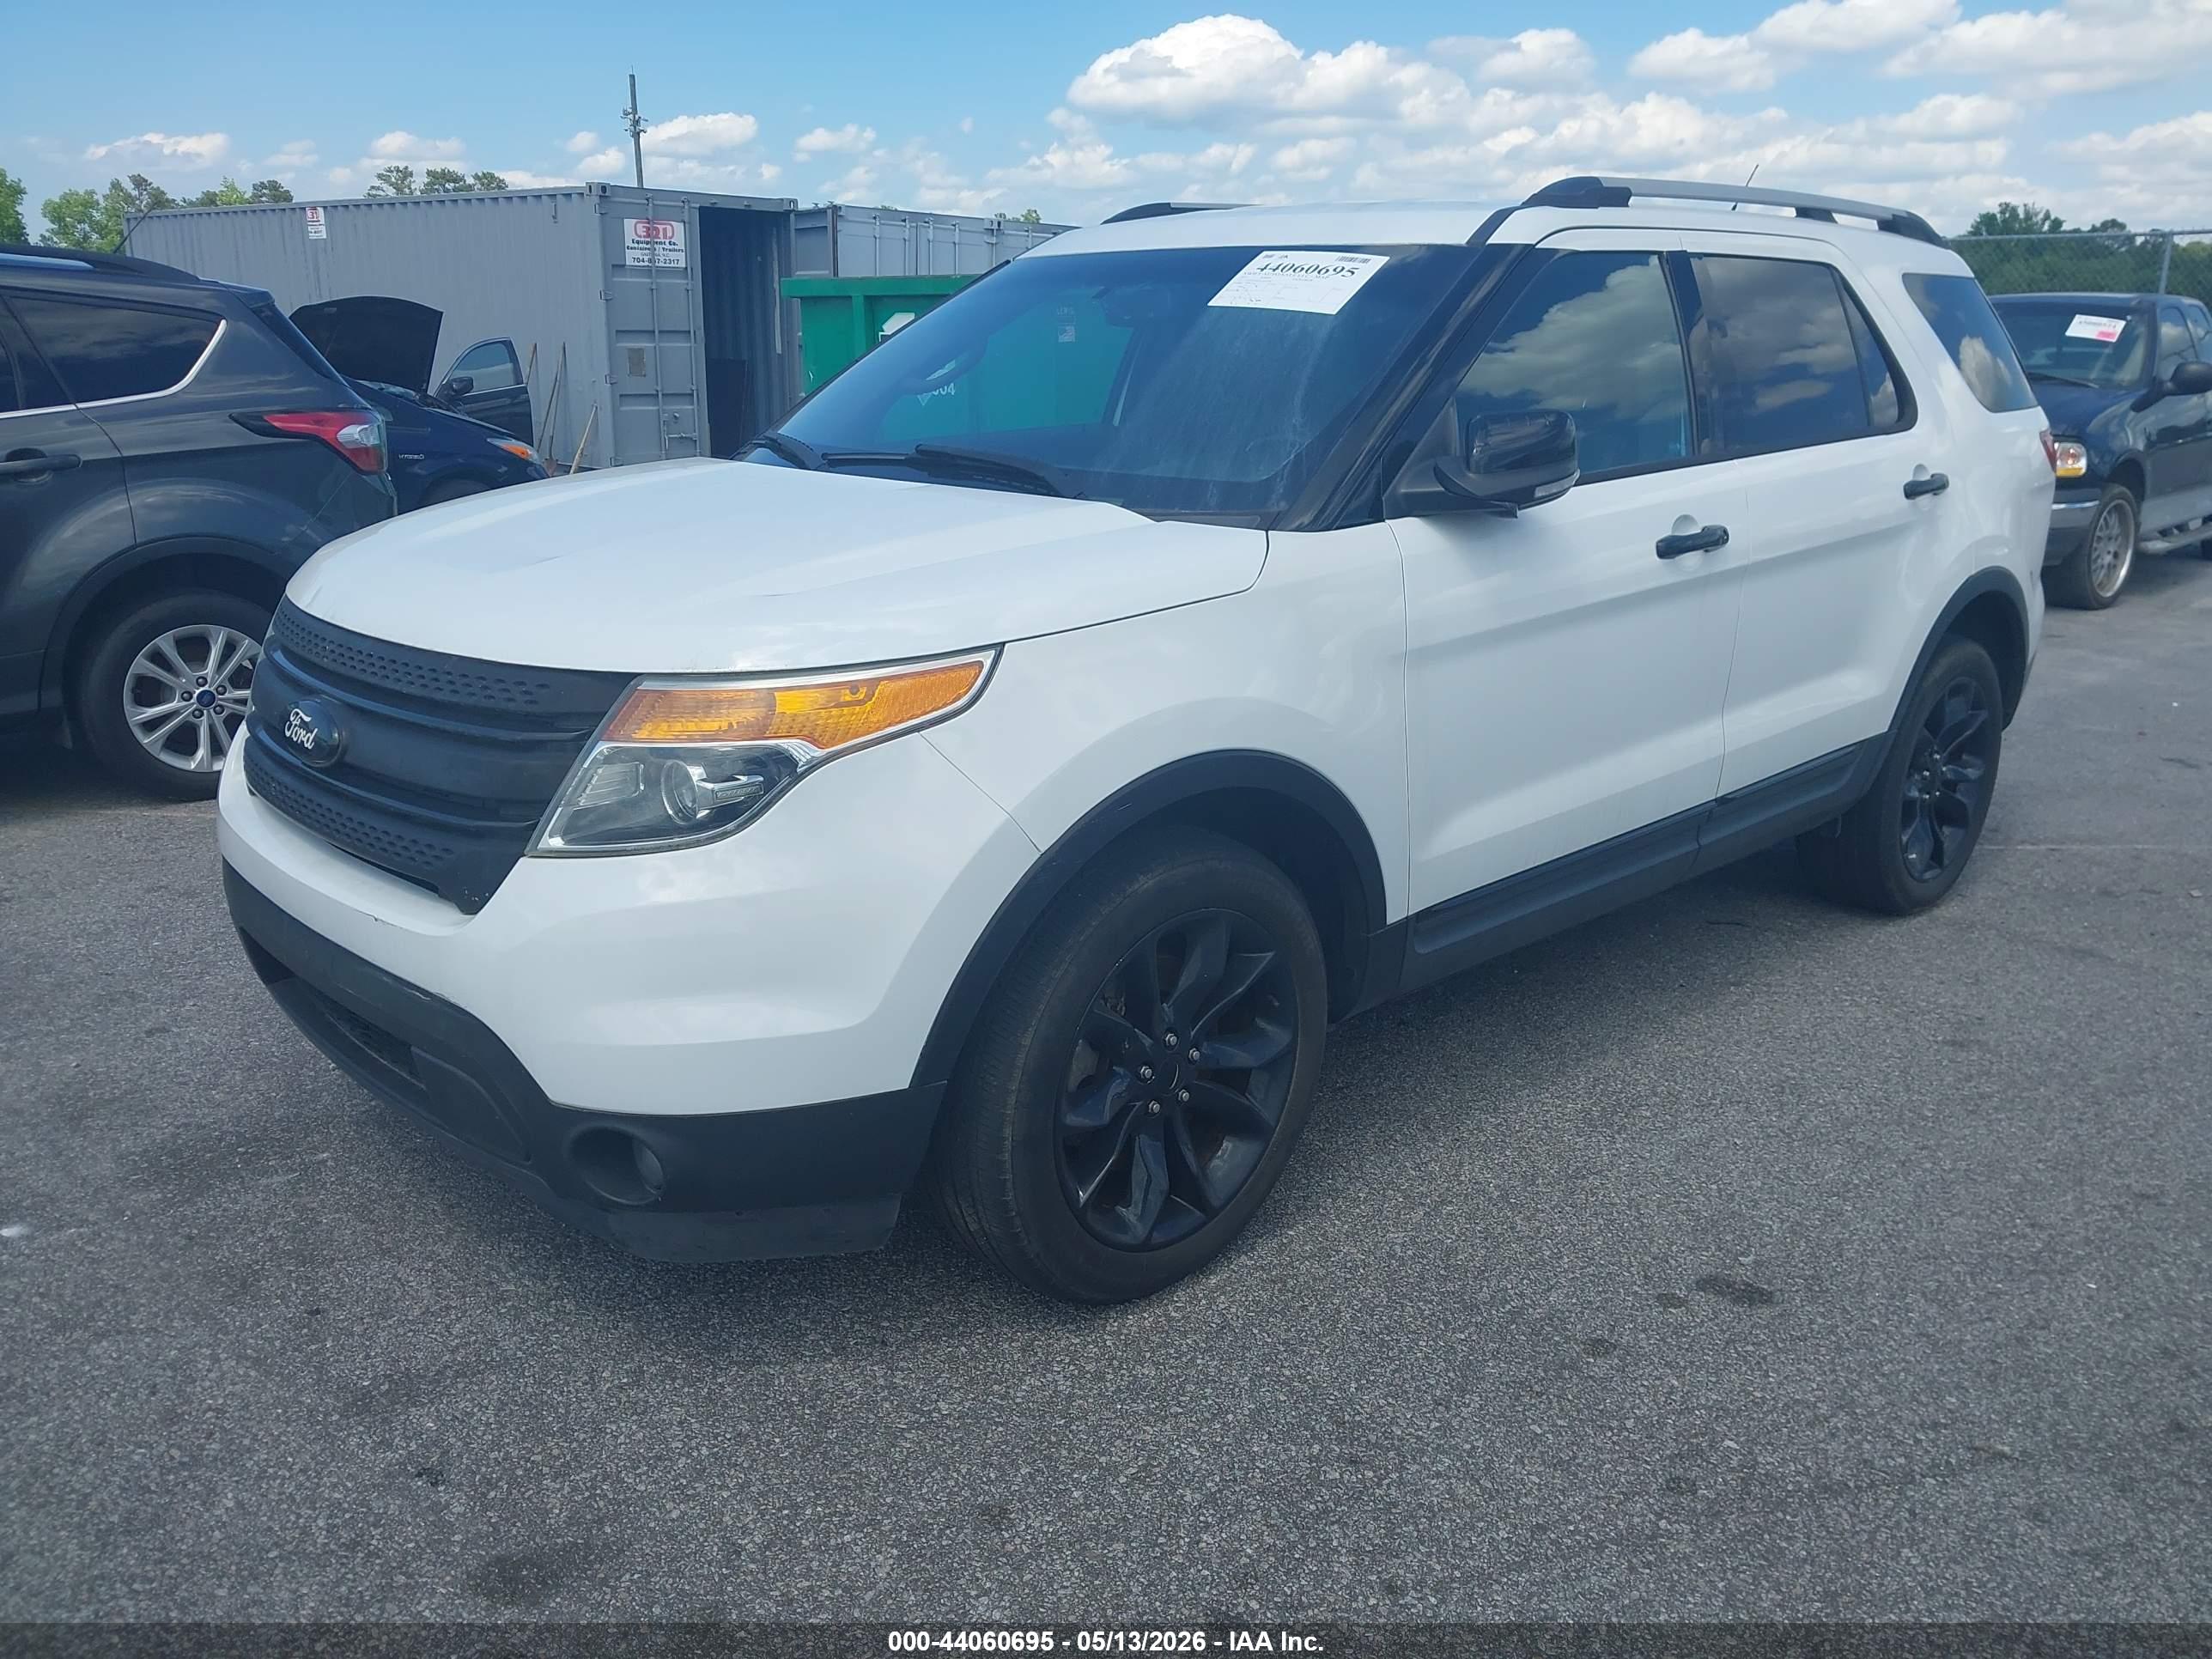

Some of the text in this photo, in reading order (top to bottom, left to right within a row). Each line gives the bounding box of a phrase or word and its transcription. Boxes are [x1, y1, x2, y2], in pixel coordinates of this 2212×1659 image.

[631, 257, 680, 265] 704-87-2317
[1256, 262, 1359, 278] 44060695
[284, 708, 319, 750] Ford
